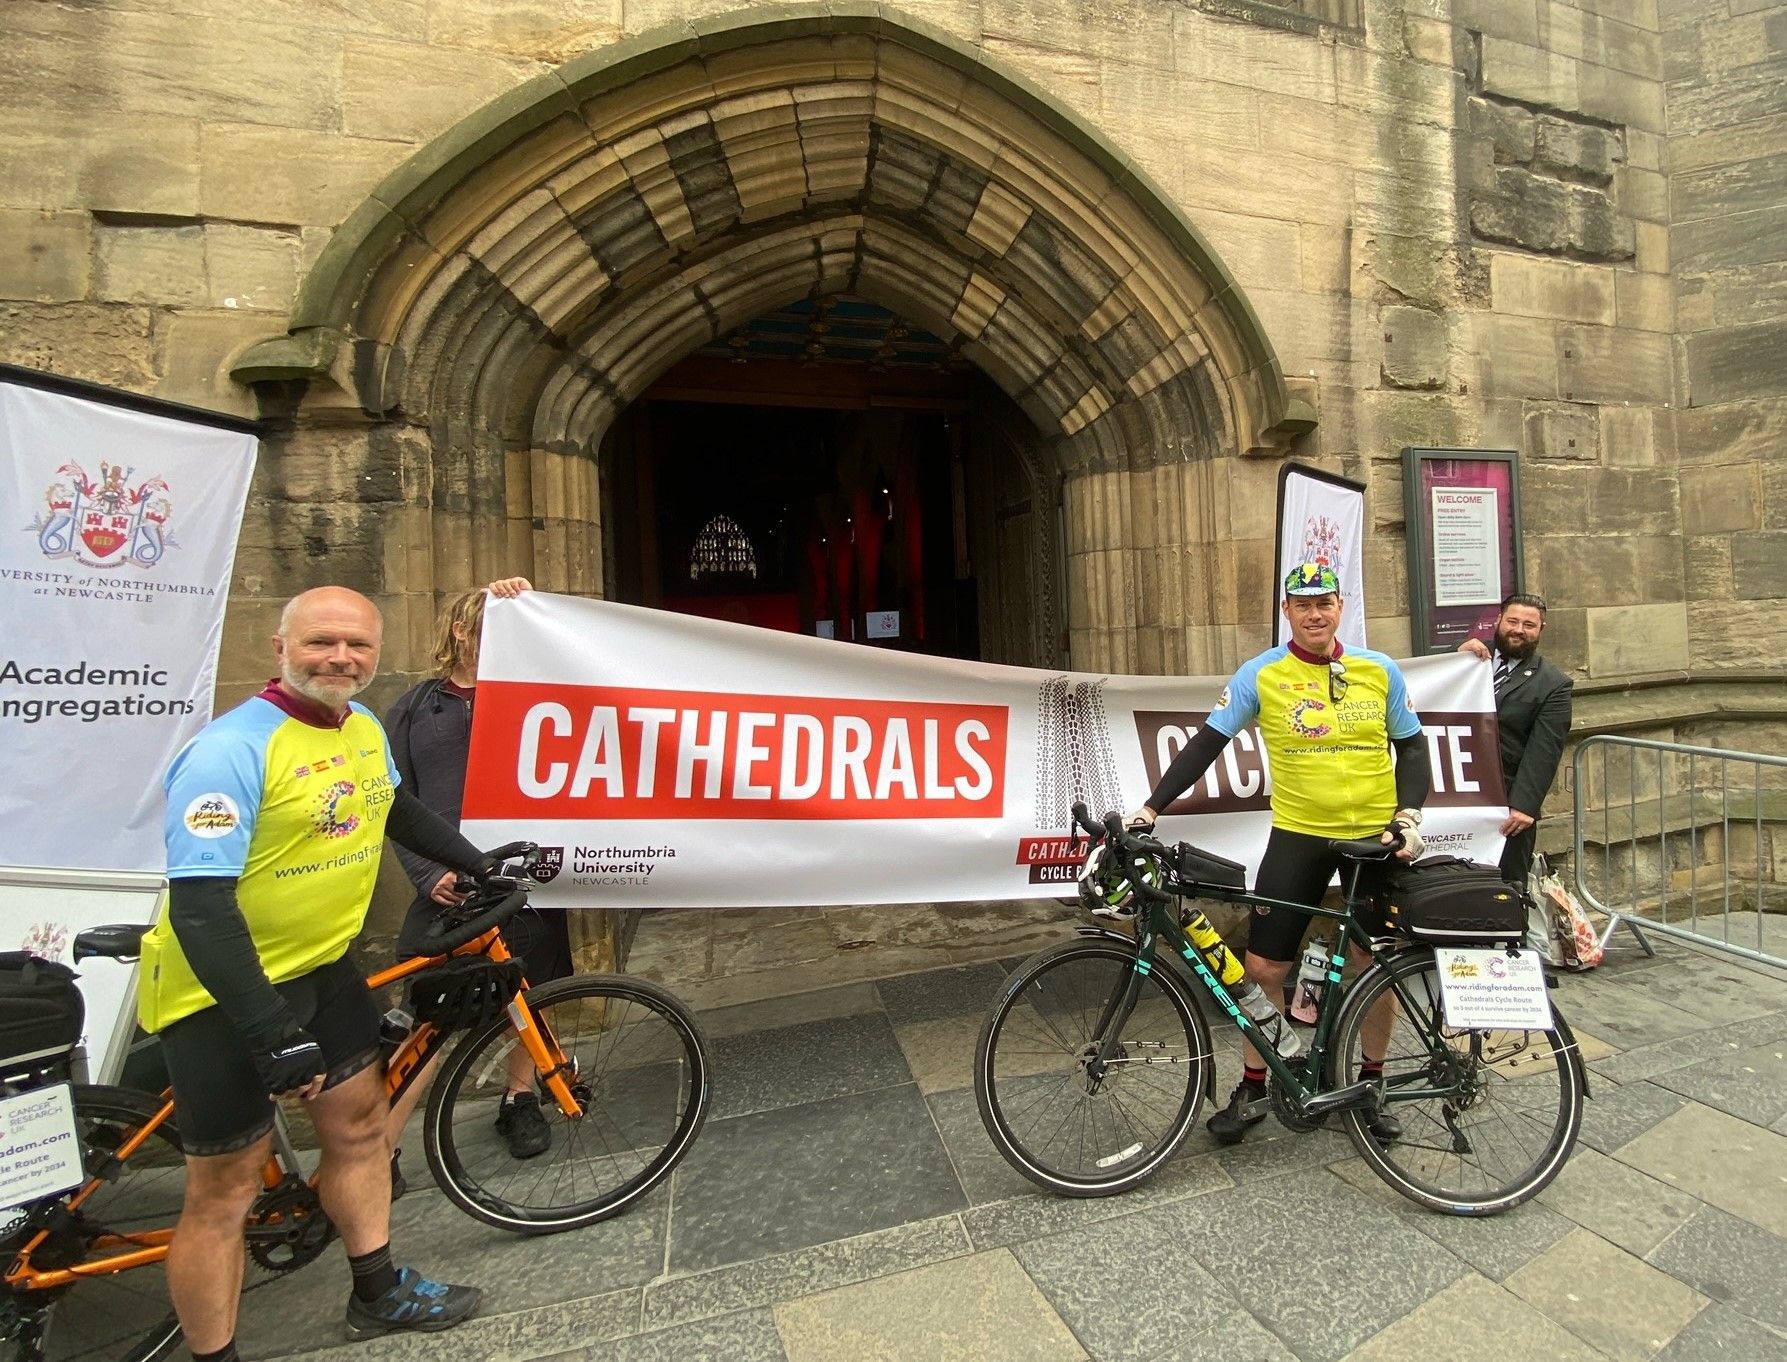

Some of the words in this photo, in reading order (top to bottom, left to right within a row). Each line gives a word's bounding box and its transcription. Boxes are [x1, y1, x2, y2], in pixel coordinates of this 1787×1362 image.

[1437, 495, 1483, 504] WELCOME
[0, 568, 73, 584] VERSITY
[79, 577, 93, 586] of
[98, 578, 215, 596] NORTHUMBRIA
[34, 587, 48, 595] at
[55, 586, 154, 603] NEWCASTLE
[0, 660, 168, 686] Academic
[2, 693, 194, 723] ngregations
[1334, 701, 1379, 712] CANCER
[1336, 711, 1385, 722] RESEARC
[1339, 723, 1356, 733] UK
[517, 701, 994, 801] CATHEDRALS
[193, 810, 231, 822] Riding
[367, 807, 380, 822] UK
[206, 819, 233, 829] Adam
[1421, 833, 1474, 843] EWCASTLE
[574, 845, 676, 859] Northumbria
[1425, 843, 1469, 852] THEDRAL
[573, 862, 655, 875] University
[1040, 865, 1073, 880] CYCLE
[573, 877, 649, 886] NEWCASTLE
[1182, 940, 1252, 1031] TREK
[1445, 983, 1543, 992] www.ridingforadam.com
[1459, 995, 1494, 1003] Cathedrals
[1495, 996, 1512, 1004] Cycle
[8, 1101, 51, 1118] CANCER
[10, 1106, 63, 1127] RESEARCH
[11, 1125, 26, 1135] UK
[15, 1154, 50, 1170] Route
[31, 1169, 42, 1177] by
[45, 1161, 66, 1173] 2034
